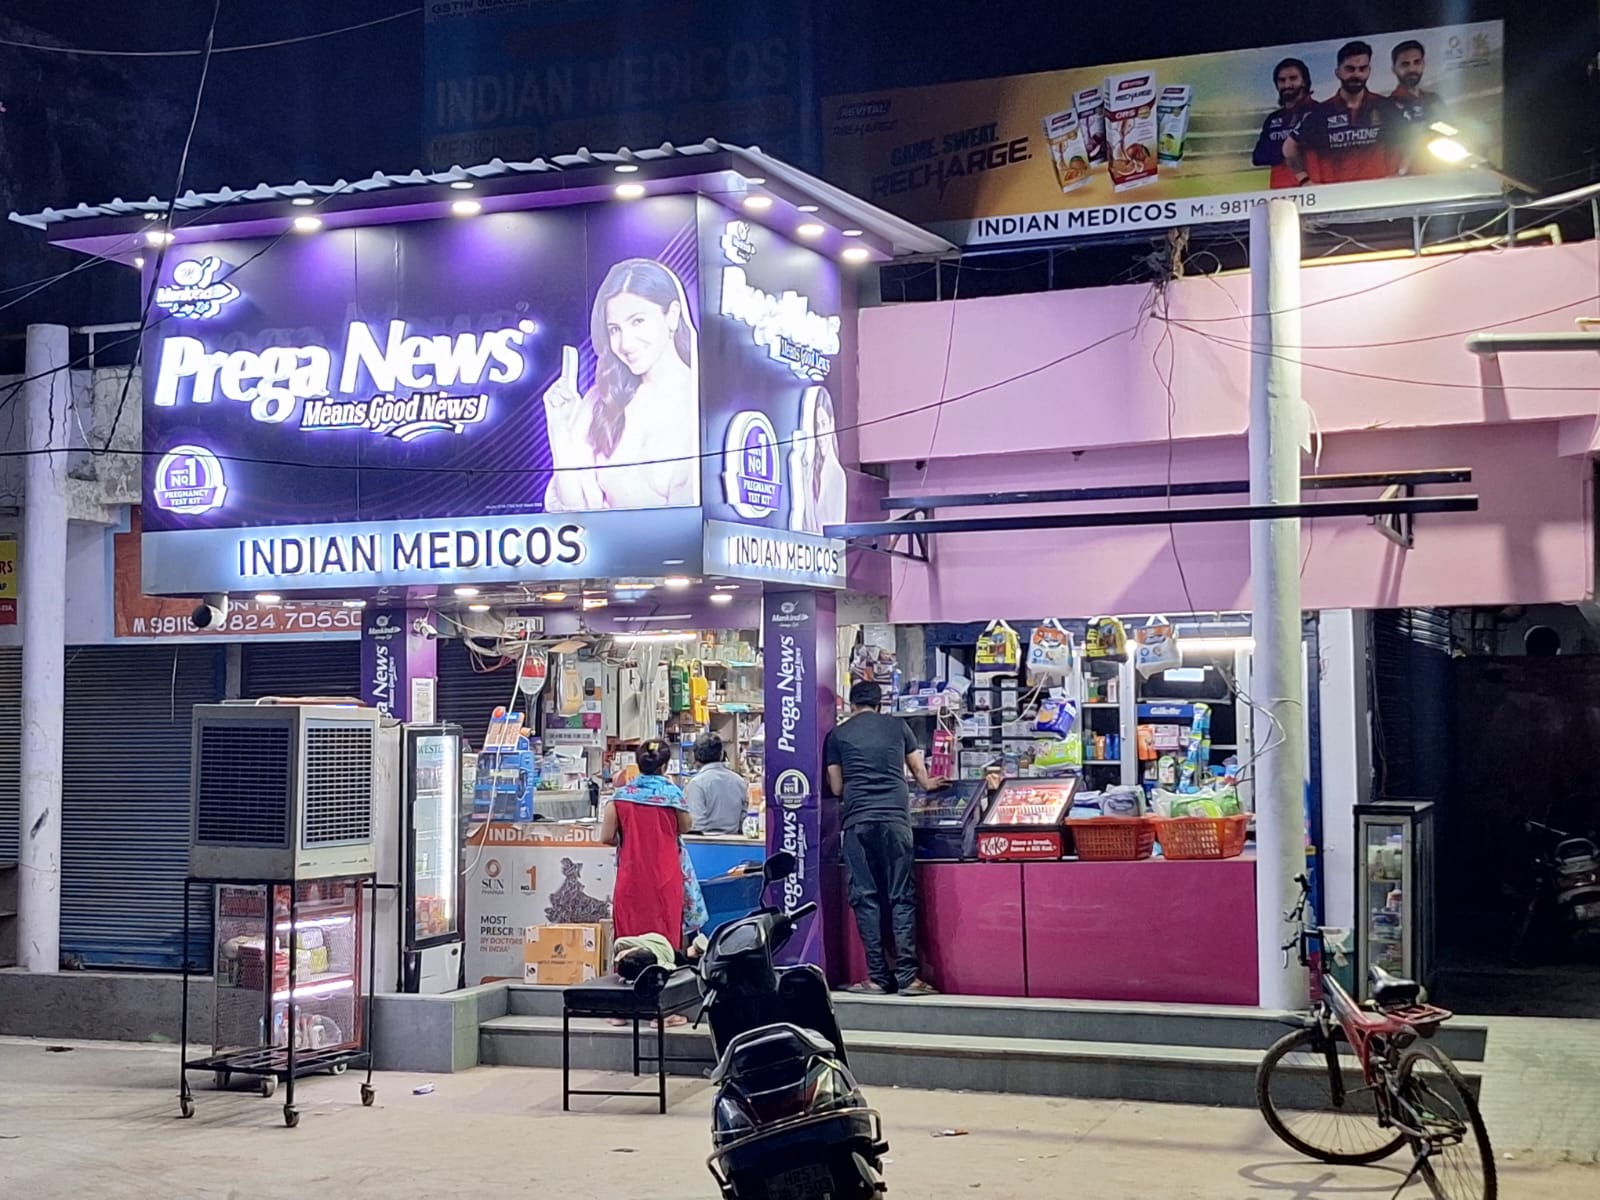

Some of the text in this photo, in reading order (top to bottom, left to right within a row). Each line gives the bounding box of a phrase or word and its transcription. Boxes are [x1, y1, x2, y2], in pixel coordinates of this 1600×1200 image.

[435, 67, 574, 128] INDIAN
[589, 39, 789, 110] MEDICOS
[1328, 128, 1380, 143] NOTHING
[870, 137, 1033, 200] RECHARGE.
[977, 213, 1059, 237] INDIAN
[1067, 202, 1178, 229] MEDICOS
[154, 319, 527, 424] Prega News
[302, 399, 367, 427] Means
[369, 396, 419, 427] Good
[164, 489, 209, 499] PREGNANCY
[238, 524, 583, 577] INDIAN MEDICOS
[736, 536, 840, 574] INDIAN MEDICOS
[372, 644, 389, 698] News
[776, 634, 795, 692] News
[778, 696, 801, 753] Prega
[481, 878, 504, 889] SUN
[525, 865, 537, 891] 1
[480, 915, 508, 925] MOST
[490, 937, 523, 945] DOCTORS
